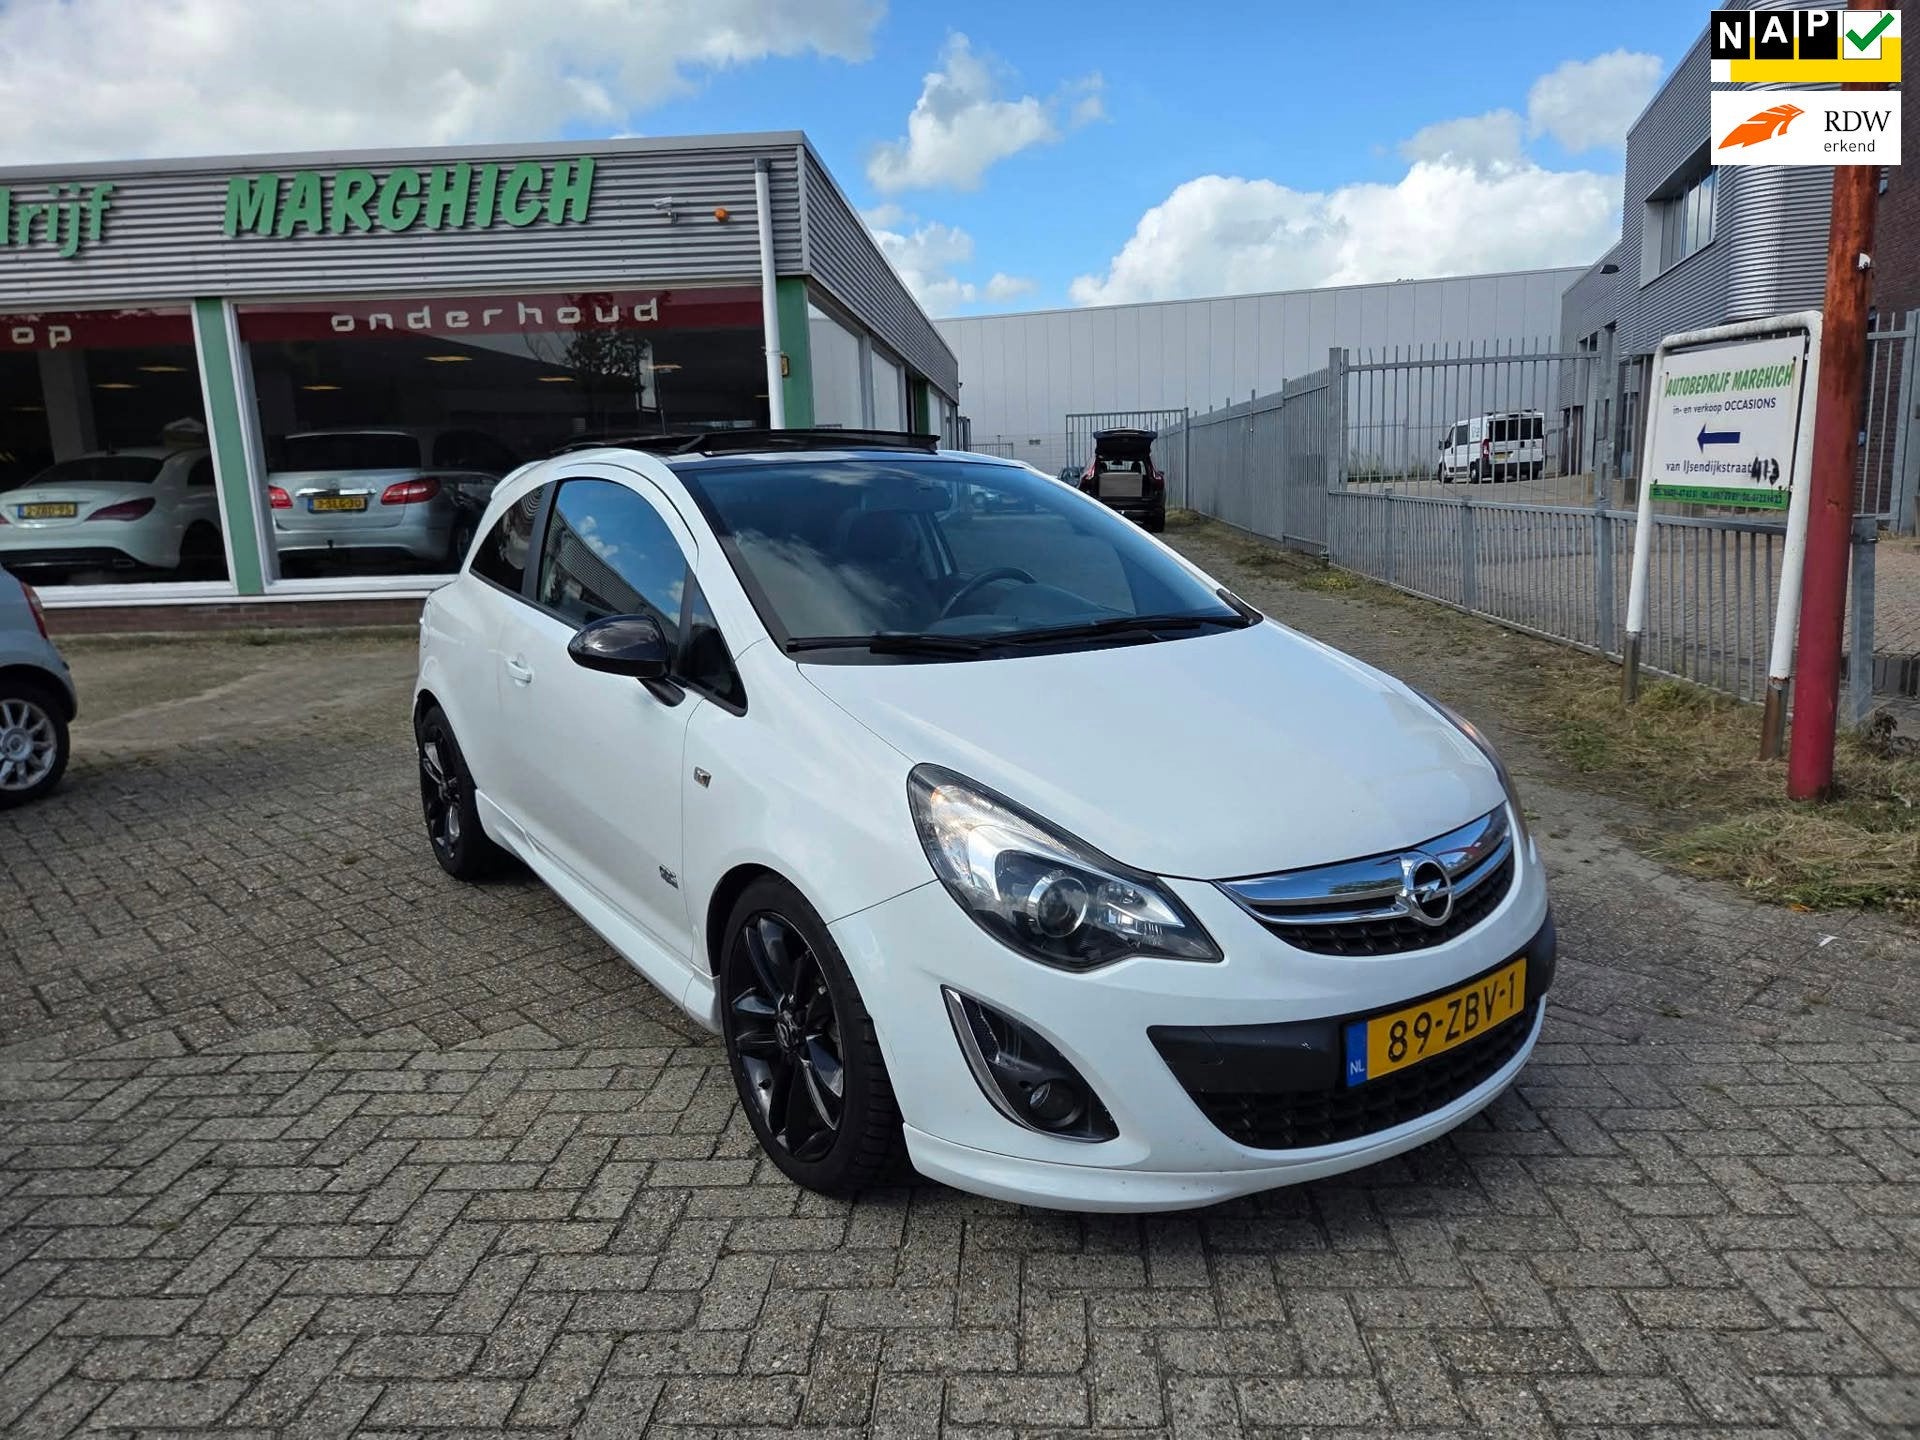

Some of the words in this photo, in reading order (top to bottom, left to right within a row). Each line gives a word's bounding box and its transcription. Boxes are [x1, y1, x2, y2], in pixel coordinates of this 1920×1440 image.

[223, 156, 595, 238] MARGHICH
[331, 297, 658, 332] onderhoud
[1665, 372, 1731, 397] AUTOBEDRIJF
[1732, 364, 1793, 391] MARGHICH
[1694, 403, 1722, 414] verkoop
[1724, 397, 1776, 411] OCCASIONS
[1666, 462, 1680, 471] van
[1387, 971, 1515, 1063] 89-ZBV-1
[1350, 1060, 1365, 1076] NL
